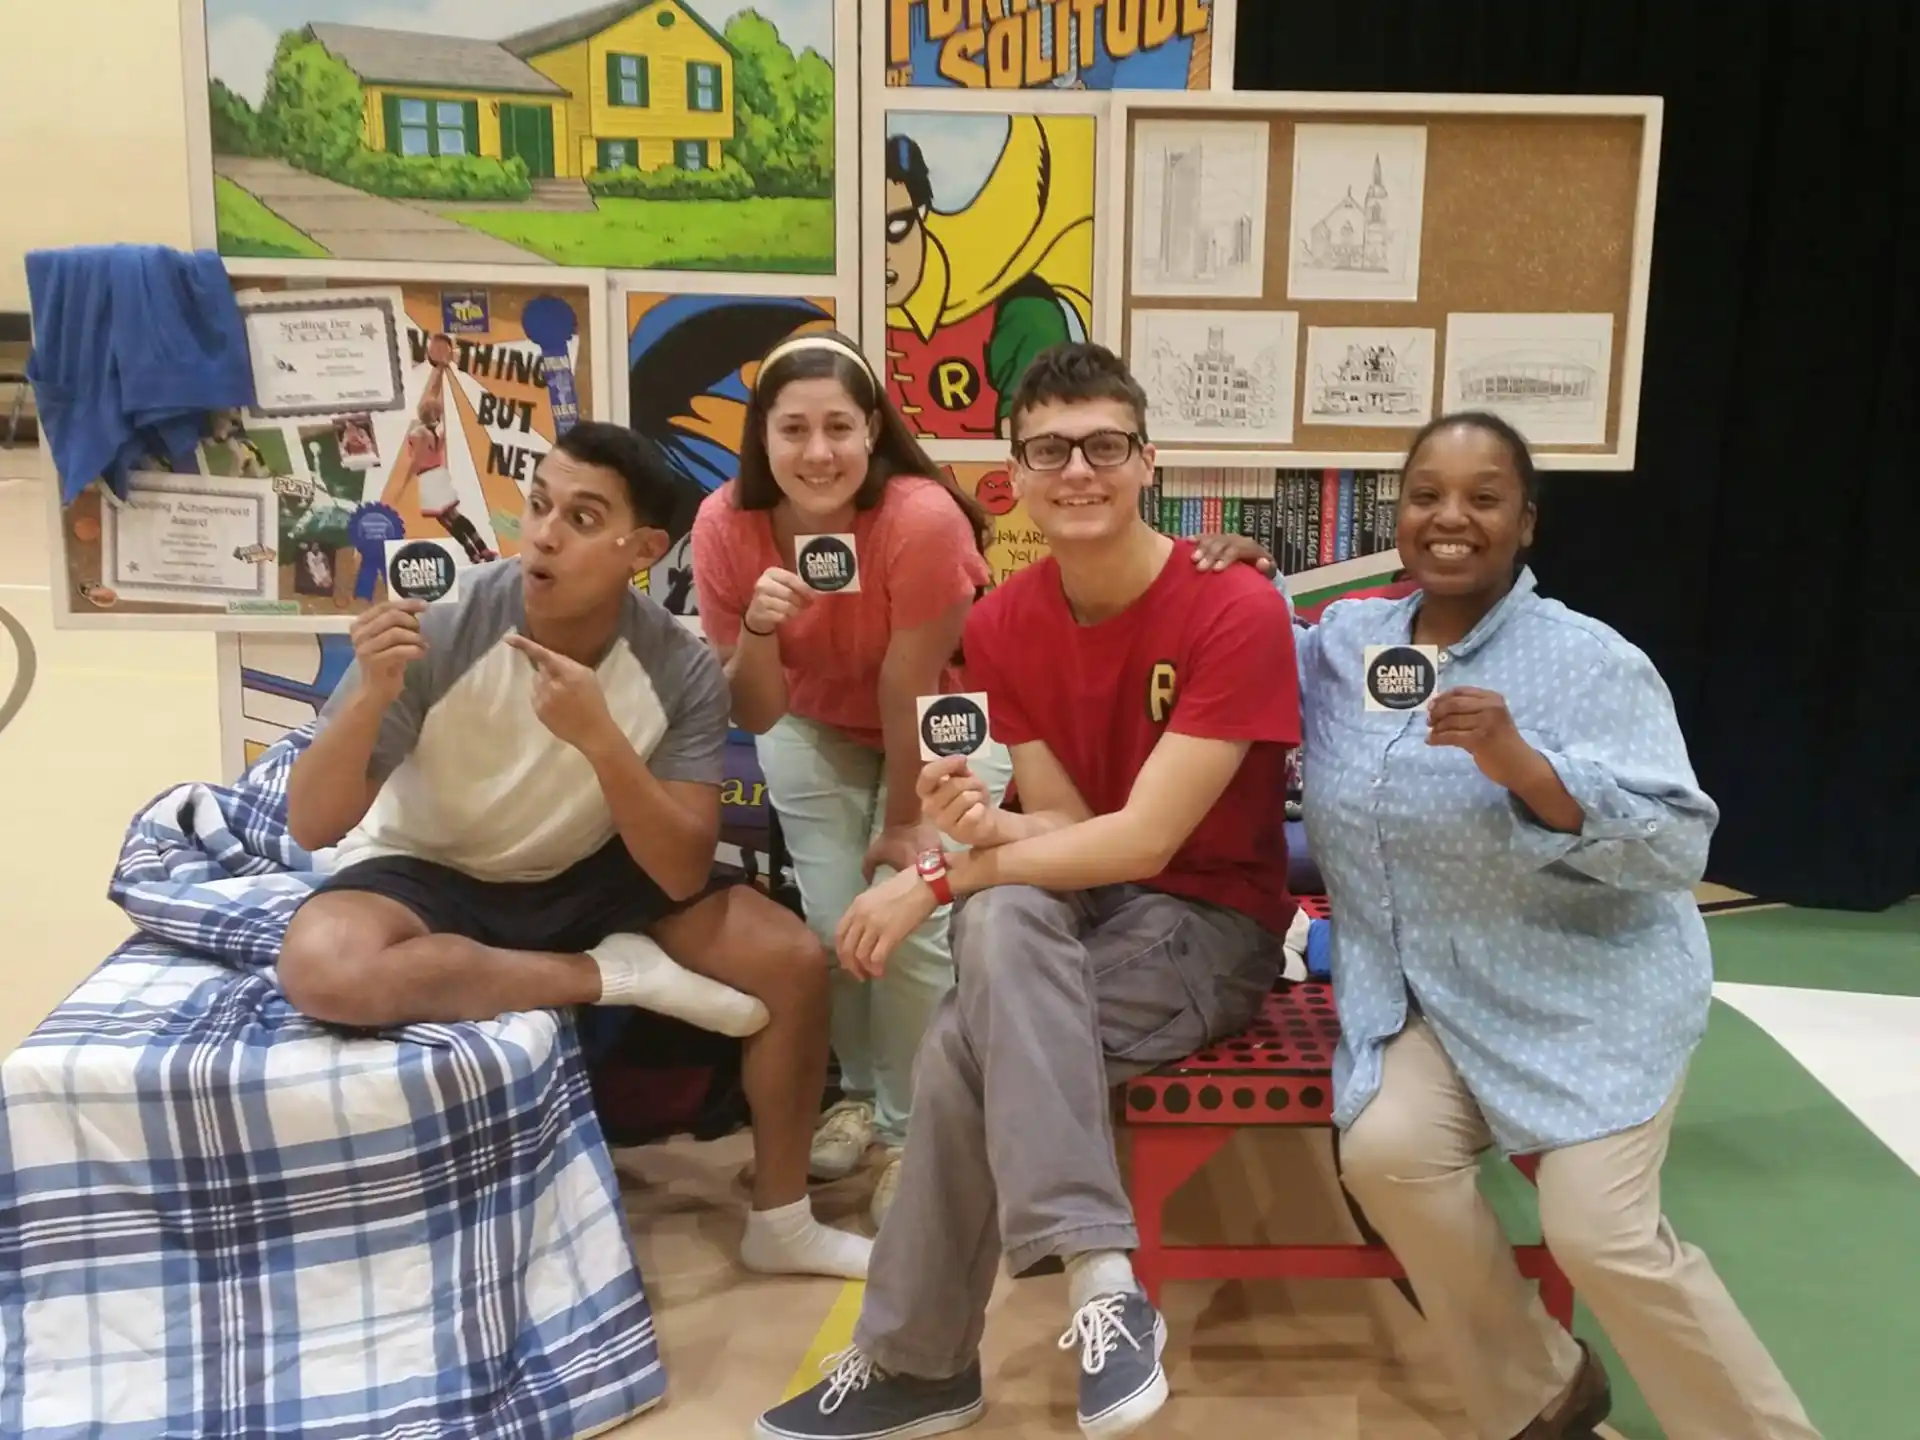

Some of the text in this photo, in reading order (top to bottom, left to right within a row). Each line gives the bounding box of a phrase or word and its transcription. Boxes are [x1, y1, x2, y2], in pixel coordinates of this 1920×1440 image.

[406, 328, 549, 389] NTHING
[938, 362, 972, 408] R
[477, 390, 537, 433] BUT
[177, 501, 251, 518] Achievement
[1244, 504, 1255, 533] IRON
[1260, 504, 1271, 535] IRON
[1363, 478, 1375, 532] BATMAN
[170, 515, 208, 528] Award
[1307, 478, 1320, 566] JUSTICE LEAGUE
[397, 557, 437, 572] CAIN
[805, 551, 839, 564] CAIN
[1376, 664, 1416, 678] CAIN
[1150, 663, 1176, 722] R
[929, 713, 968, 728] CAIN
